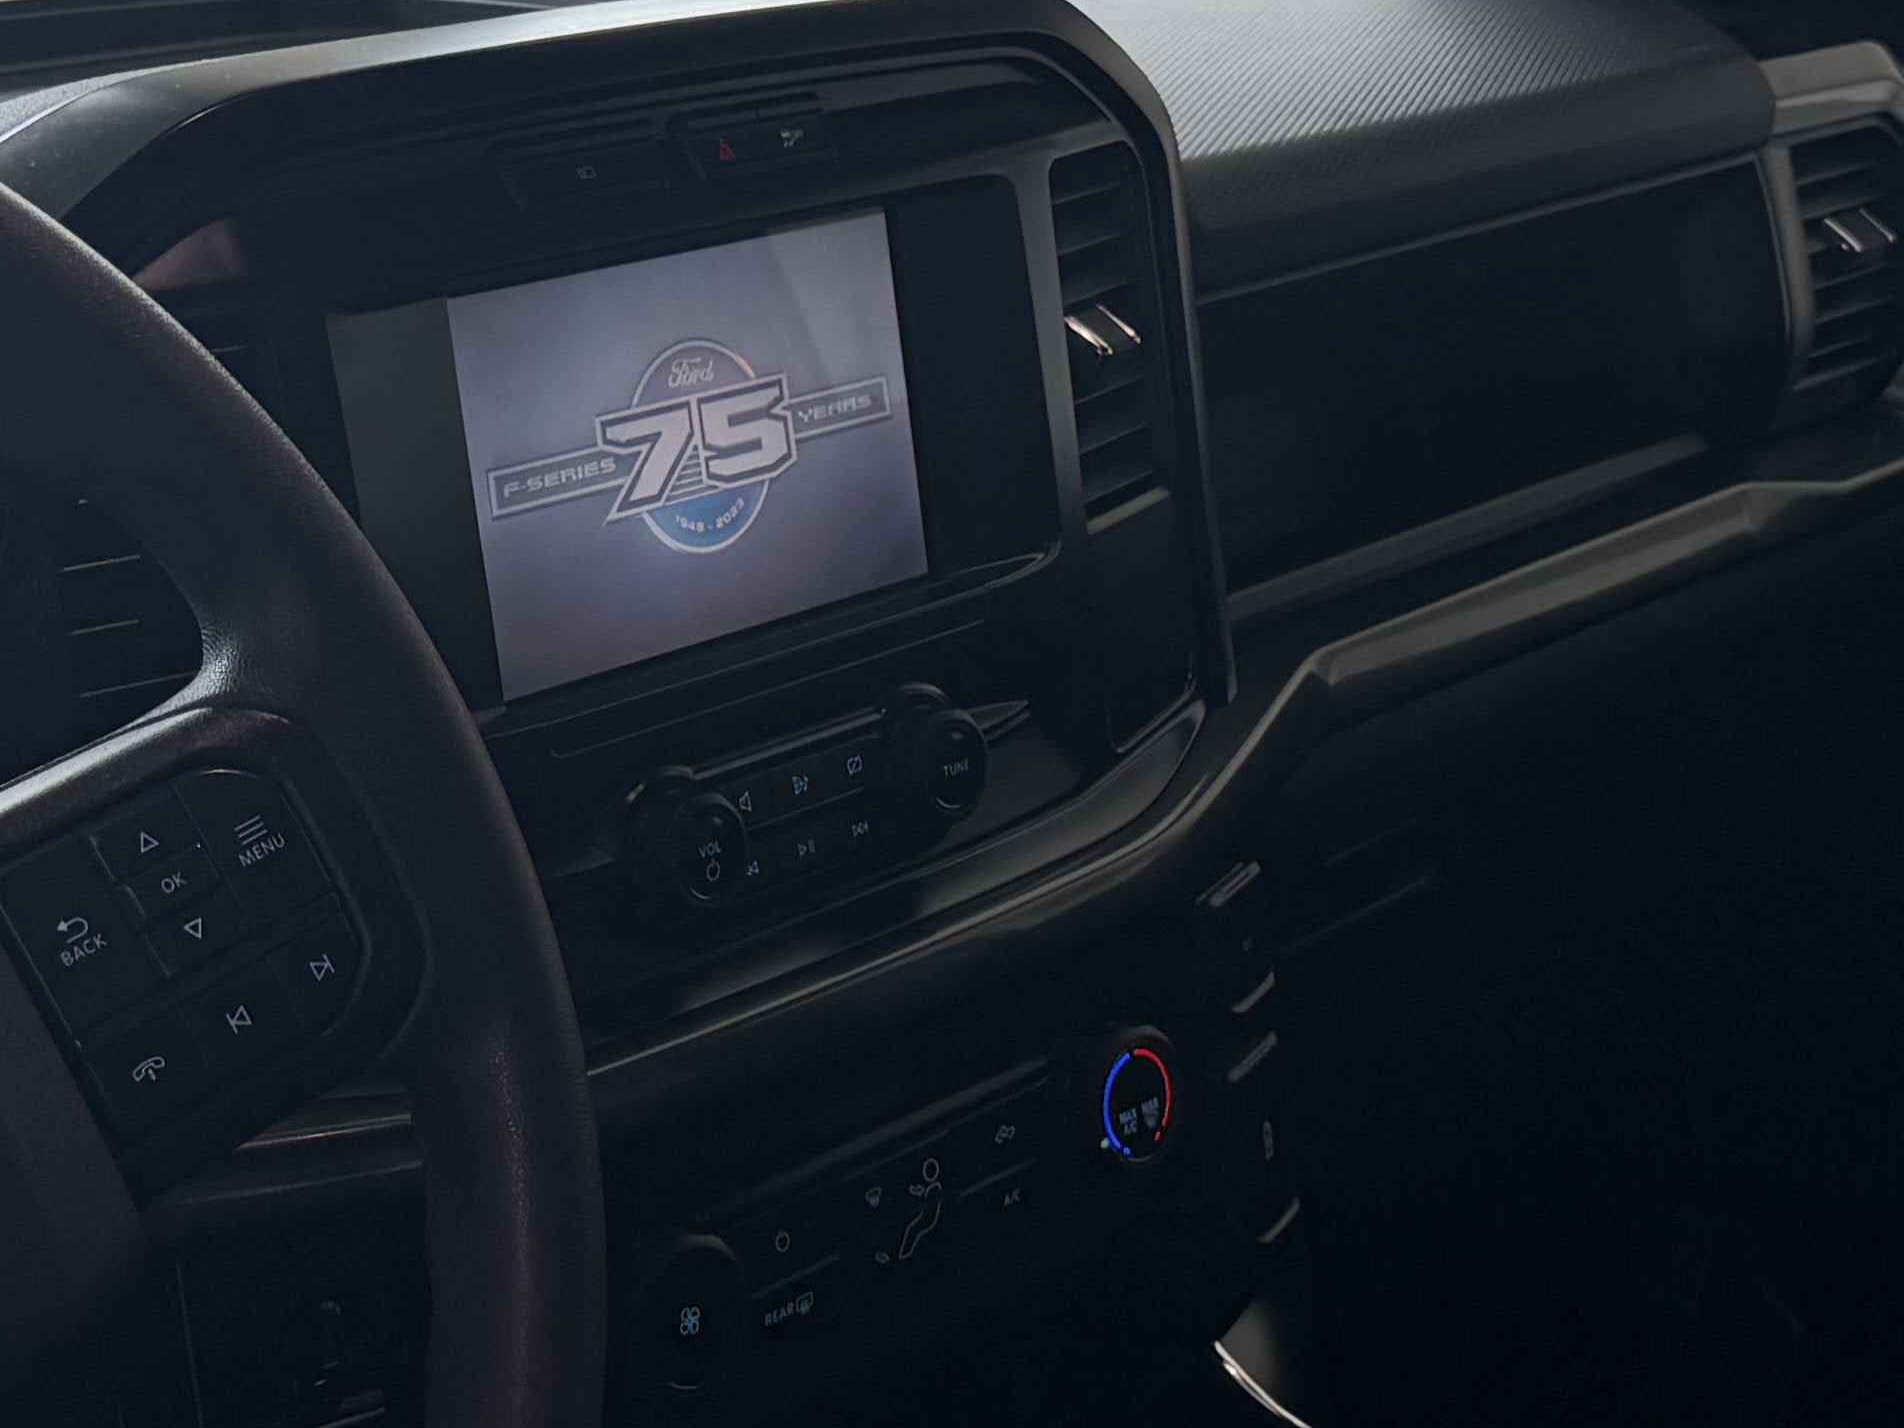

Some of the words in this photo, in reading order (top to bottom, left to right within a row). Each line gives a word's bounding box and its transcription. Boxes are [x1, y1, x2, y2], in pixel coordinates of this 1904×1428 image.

[668, 357, 715, 388] Ford
[503, 457, 617, 498] F-SERIES
[601, 380, 794, 512] 75
[798, 394, 873, 424] YEARS
[942, 758, 970, 777] TUNE
[238, 832, 286, 868] MENU
[698, 839, 722, 859] VOL
[160, 872, 188, 894] OK
[59, 932, 108, 967] BACK
[764, 1301, 796, 1327] REAR
